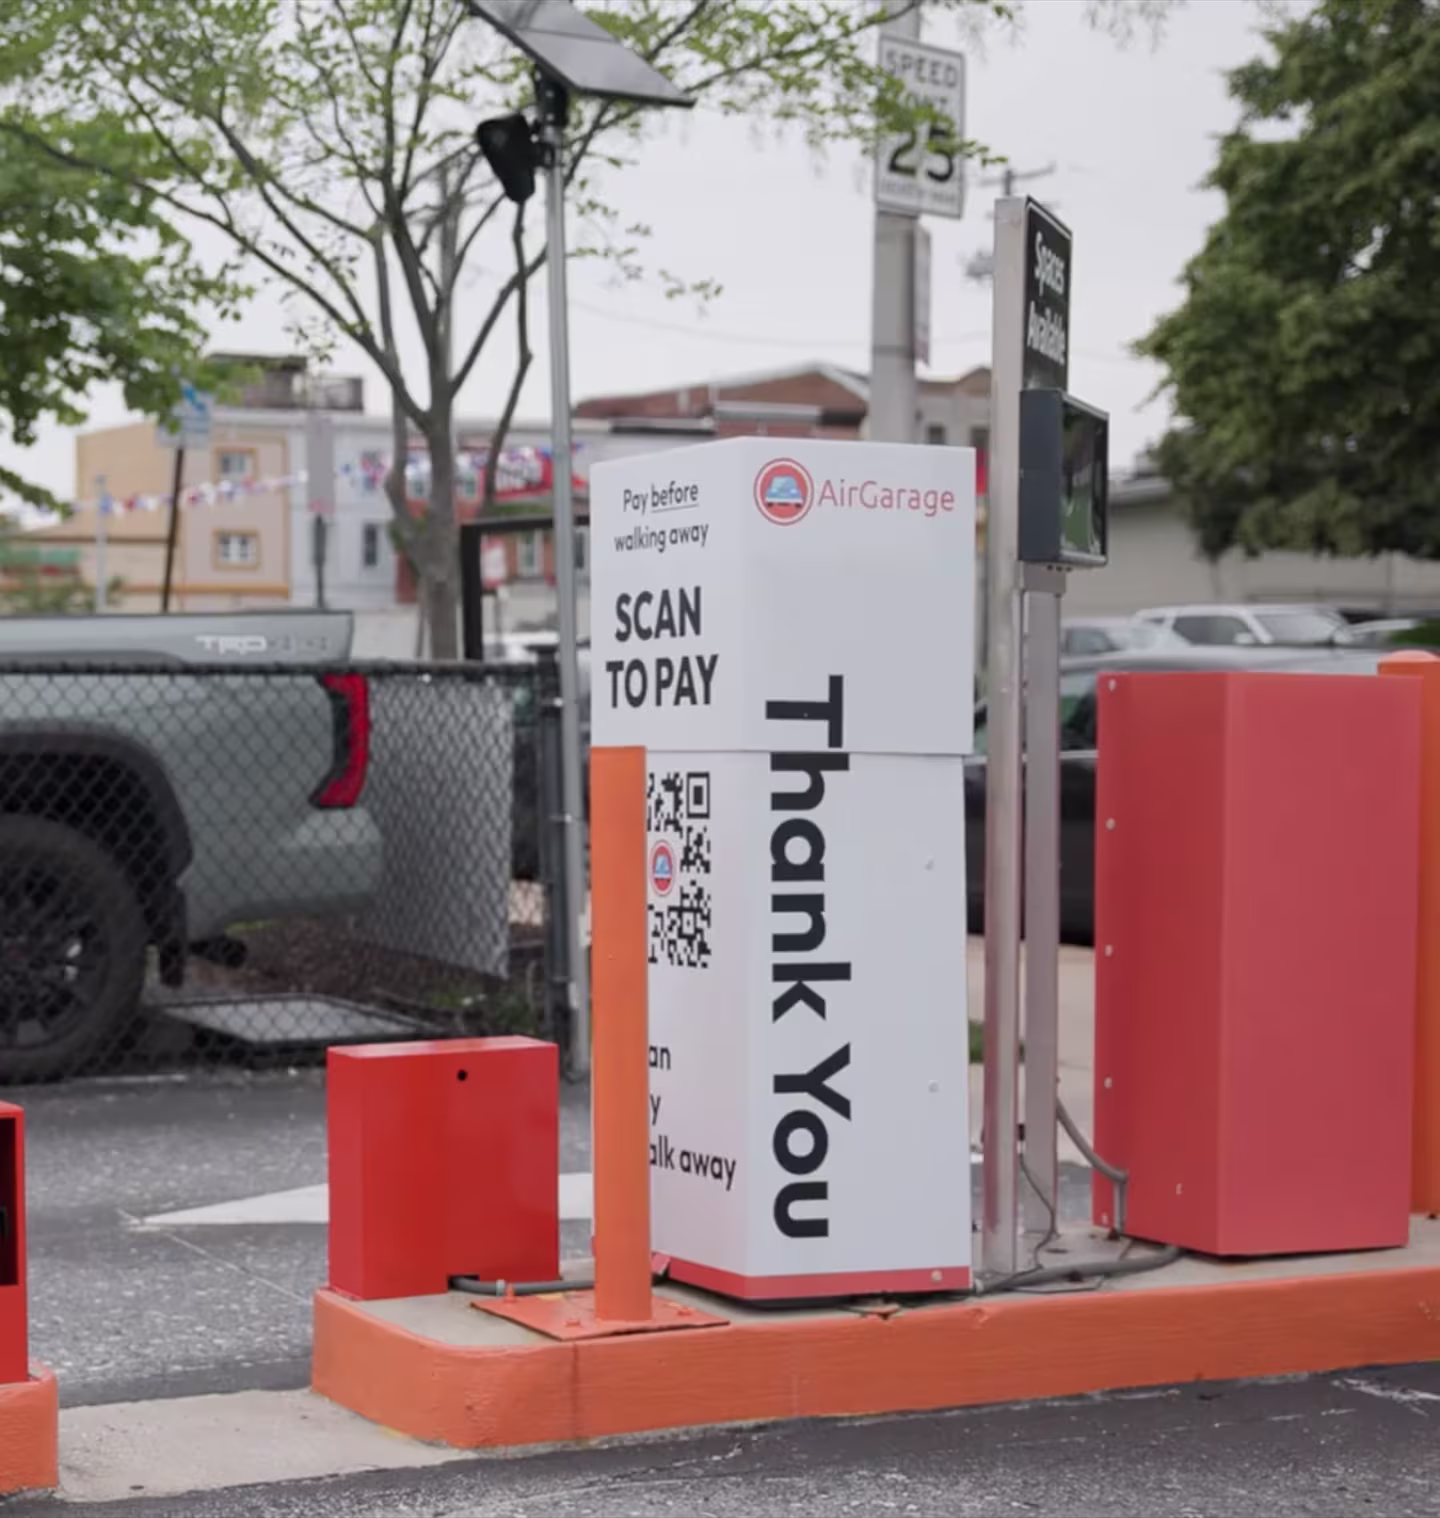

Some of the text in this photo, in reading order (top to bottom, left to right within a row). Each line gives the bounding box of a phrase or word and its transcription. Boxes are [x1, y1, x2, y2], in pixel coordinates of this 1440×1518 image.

[886, 50, 957, 88] SPEED
[888, 121, 953, 182] 25
[1034, 230, 1064, 296] Spaces
[1026, 300, 1065, 366] Available
[623, 481, 699, 515] Pay before
[818, 479, 955, 517] AirGarage
[614, 522, 709, 553] walking away
[615, 585, 701, 643] SCAN
[606, 653, 719, 709] TO PAY
[766, 675, 851, 1240] Thank You
[649, 1045, 671, 1071] an
[649, 1134, 736, 1191] alk away
